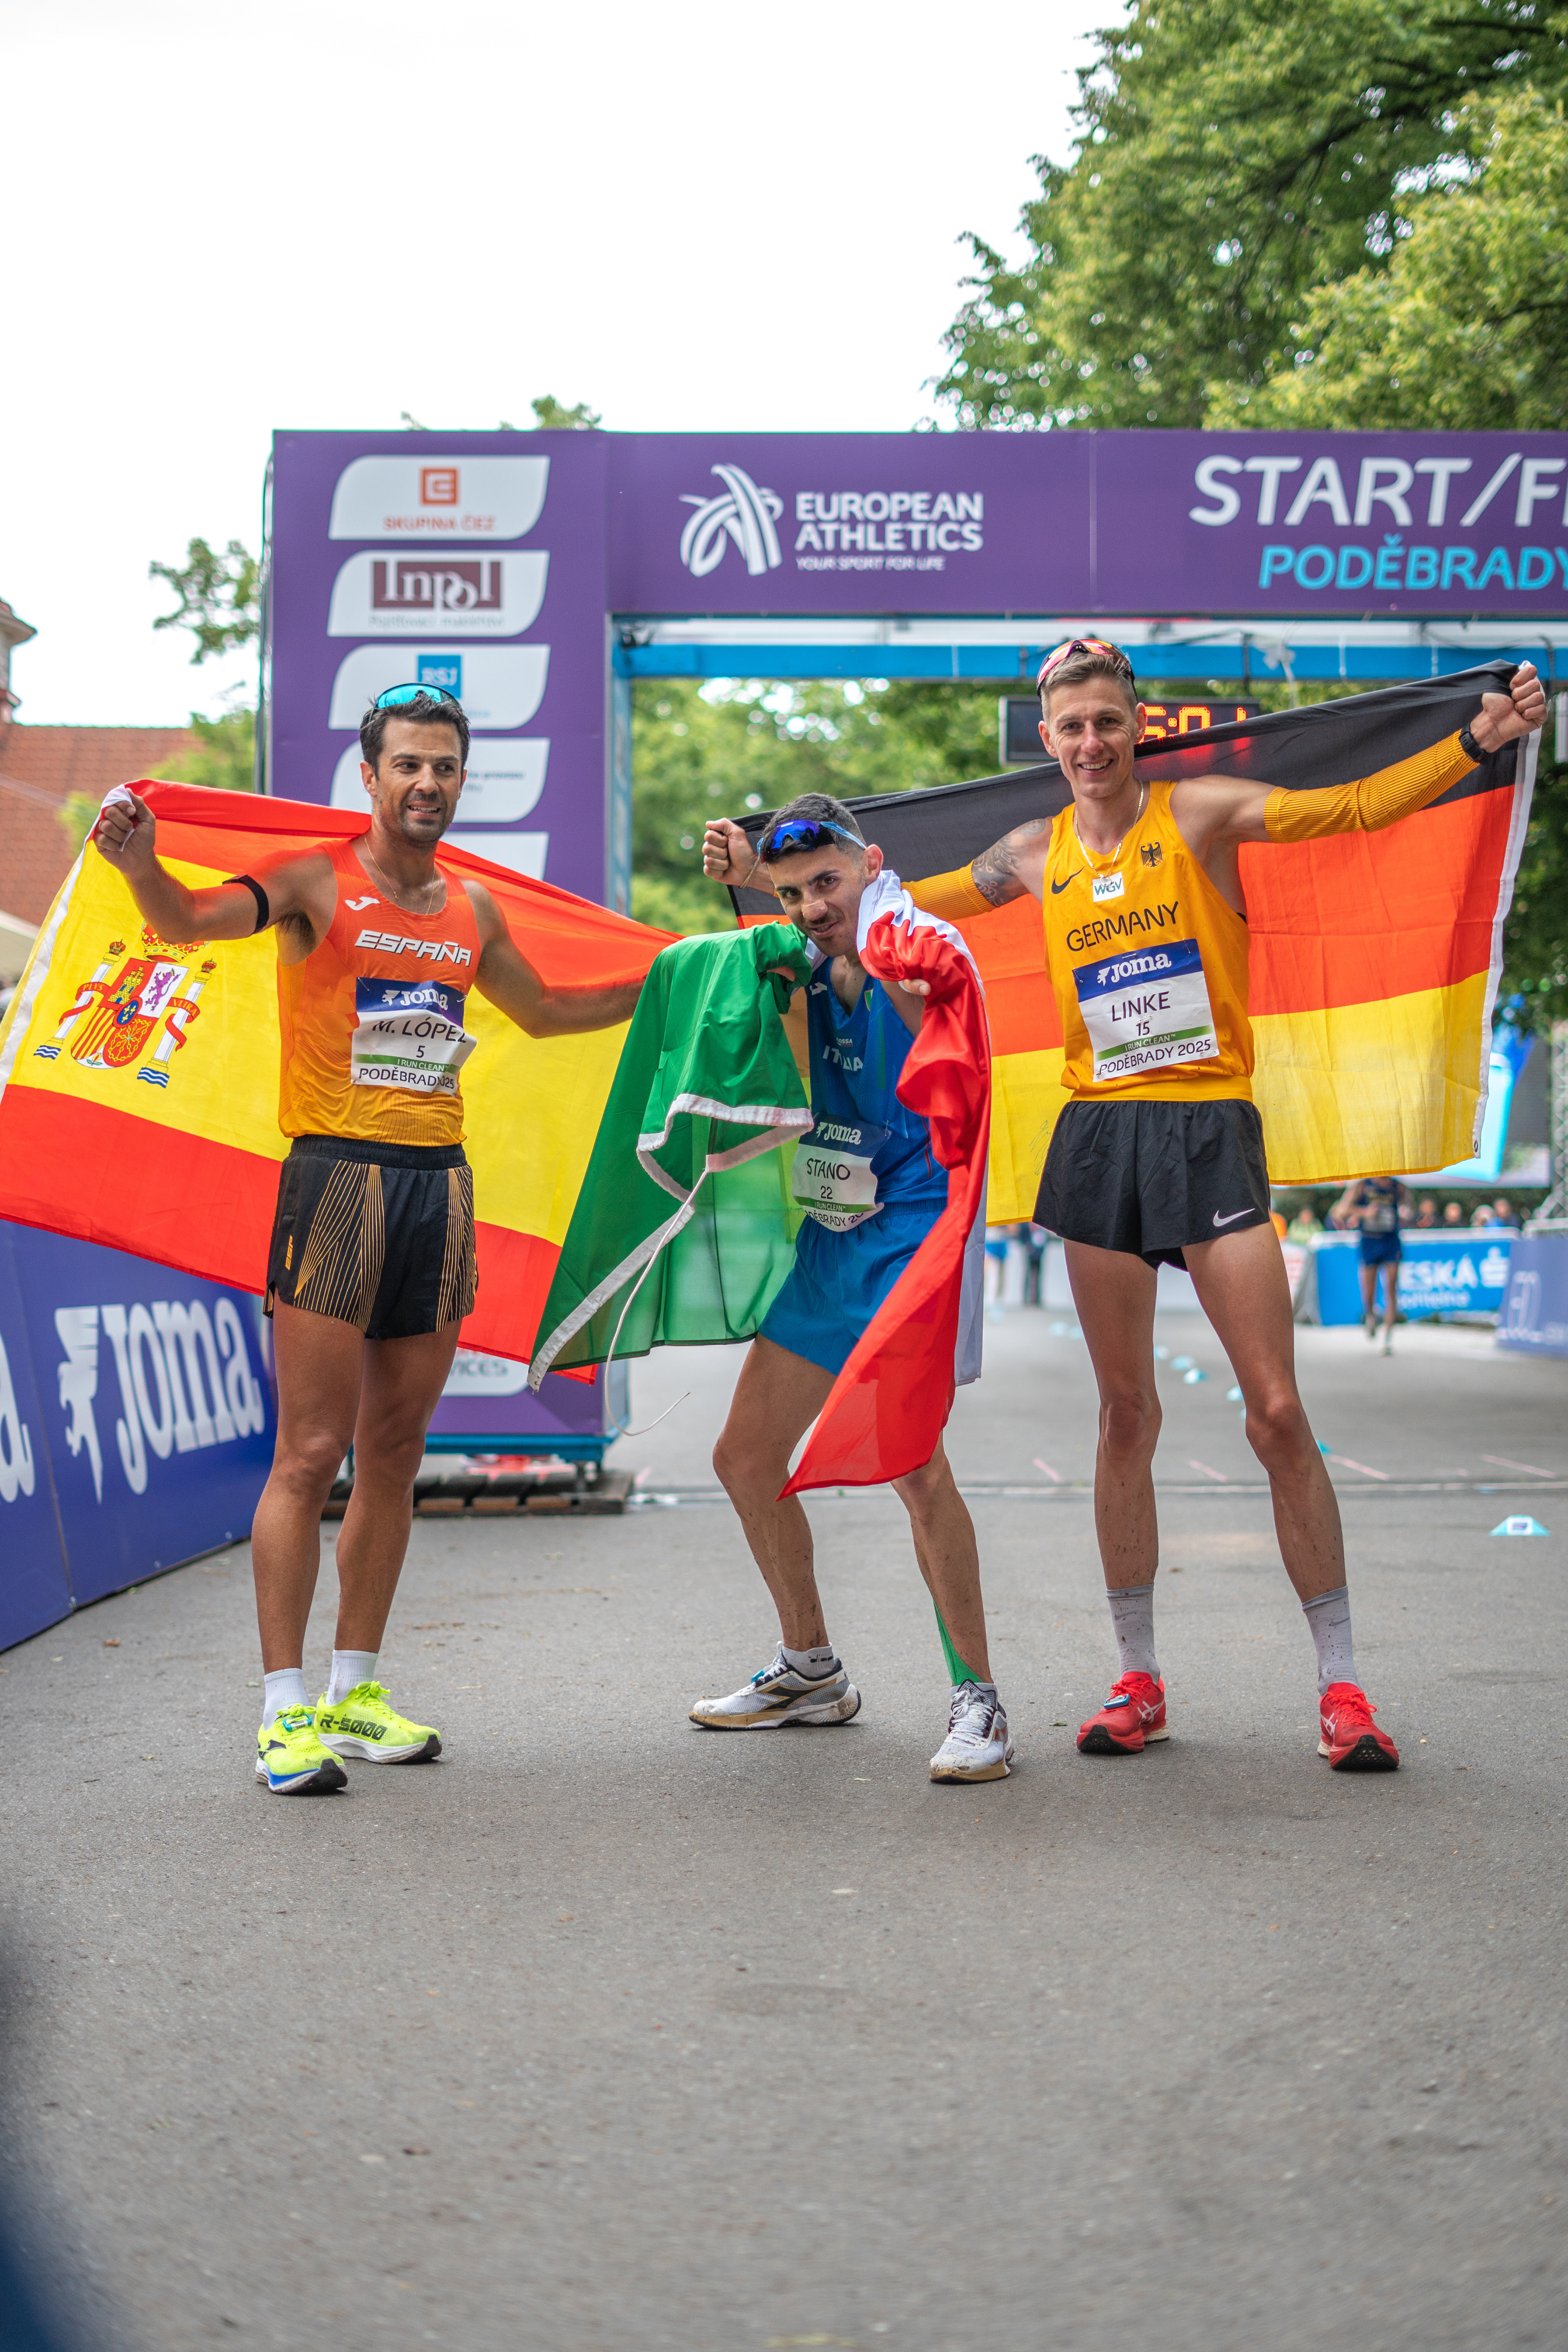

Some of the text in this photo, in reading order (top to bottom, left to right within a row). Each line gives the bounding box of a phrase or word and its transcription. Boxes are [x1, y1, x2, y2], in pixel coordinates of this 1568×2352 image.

[795, 491, 983, 521] EUROPEAN
[383, 514, 496, 531] SKUPINA ČEZ
[794, 522, 984, 551] ATHLETICS
[796, 555, 945, 571] YOUR SPORT FOR LIFE
[382, 561, 493, 611] Inpol
[1094, 878, 1123, 895] WGV
[1066, 901, 1179, 952] GERMANY
[354, 929, 472, 967] ESPAÑA
[1111, 991, 1171, 1022] LINKE
[372, 1020, 395, 1033] M.
[1136, 1021, 1150, 1036] 15
[416, 1045, 425, 1058] 5
[1128, 1041, 1142, 1051] RUN
[1099, 1039, 1211, 1075] PODĚBRADY 2025
[359, 1067, 439, 1087] PODĚBRAD
[807, 1158, 851, 1180] STANO
[820, 1185, 833, 1199] 22
[320, 1714, 388, 1740] R-5000
